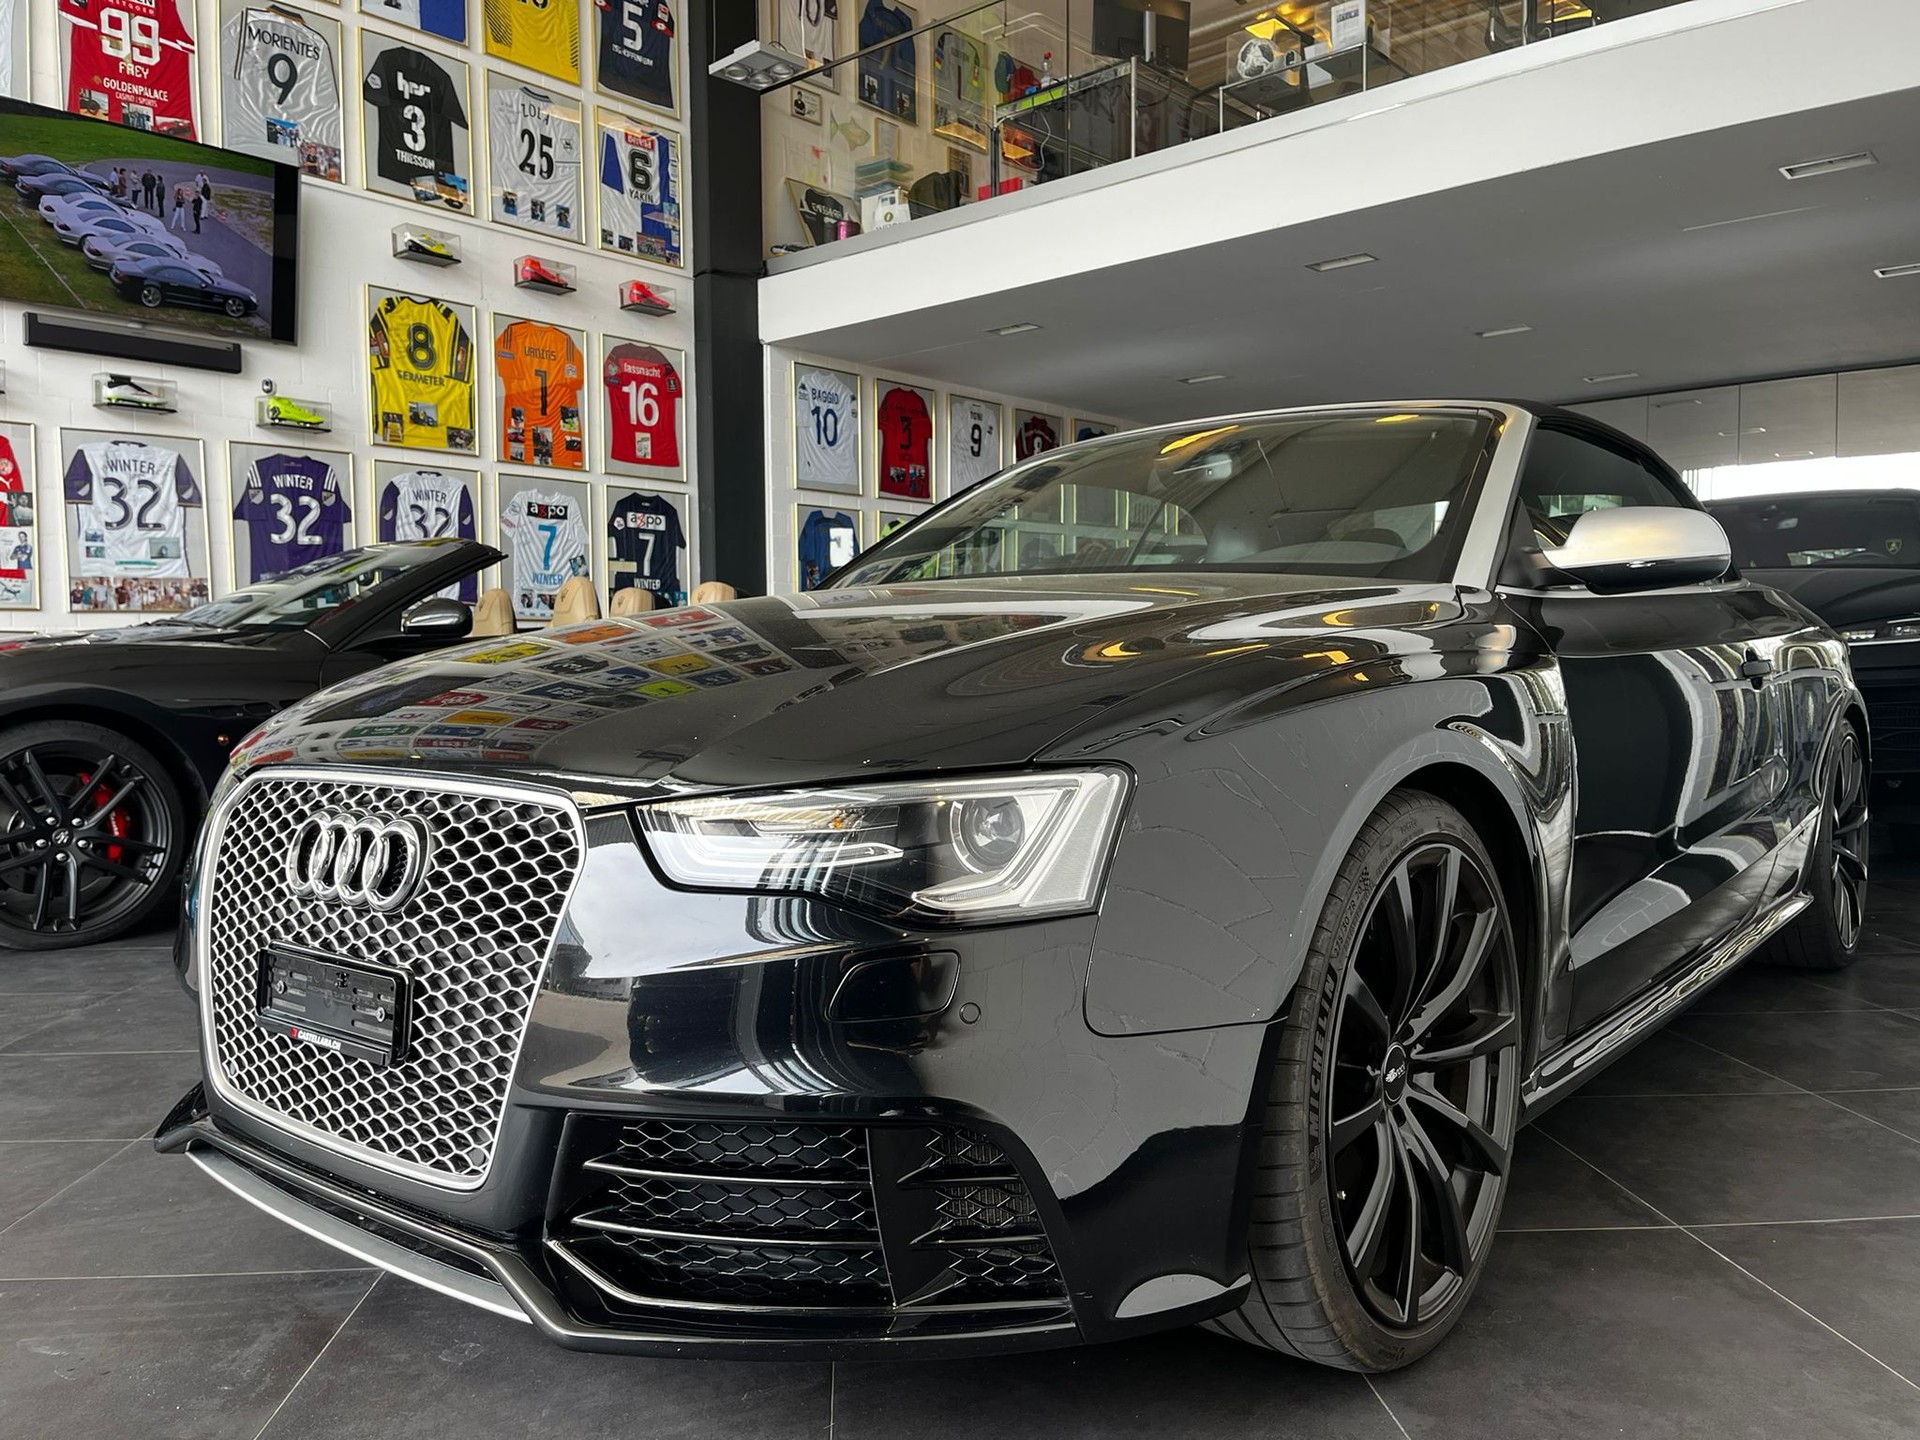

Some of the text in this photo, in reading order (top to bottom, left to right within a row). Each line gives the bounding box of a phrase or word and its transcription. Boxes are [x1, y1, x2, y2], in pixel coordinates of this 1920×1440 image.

[100, 7, 160, 65] 99
[248, 25, 320, 61] MORIENTES
[623, 1, 643, 51] 5
[103, 77, 169, 102] GOLDENPALACE
[267, 53, 298, 105] 9
[403, 105, 426, 151] 3
[519, 128, 554, 179] 25
[628, 149, 652, 192] 6
[407, 322, 436, 371] 8
[534, 368, 548, 416] 1
[621, 380, 660, 427] 16
[811, 388, 839, 405] BAGGIO
[811, 406, 838, 447] 10
[970, 423, 982, 457] 9
[107, 459, 155, 475] WINTER
[272, 473, 314, 491] WINTER
[103, 477, 166, 531] 32
[412, 489, 447, 504] WINTER
[270, 493, 323, 545] 32
[410, 504, 452, 538] 32
[538, 524, 557, 571] 7
[639, 533, 655, 576] 7
[532, 572, 564, 585] WINTER
[633, 578, 661, 590] WINTER
[1309, 973, 1336, 1138] MICHELIN
